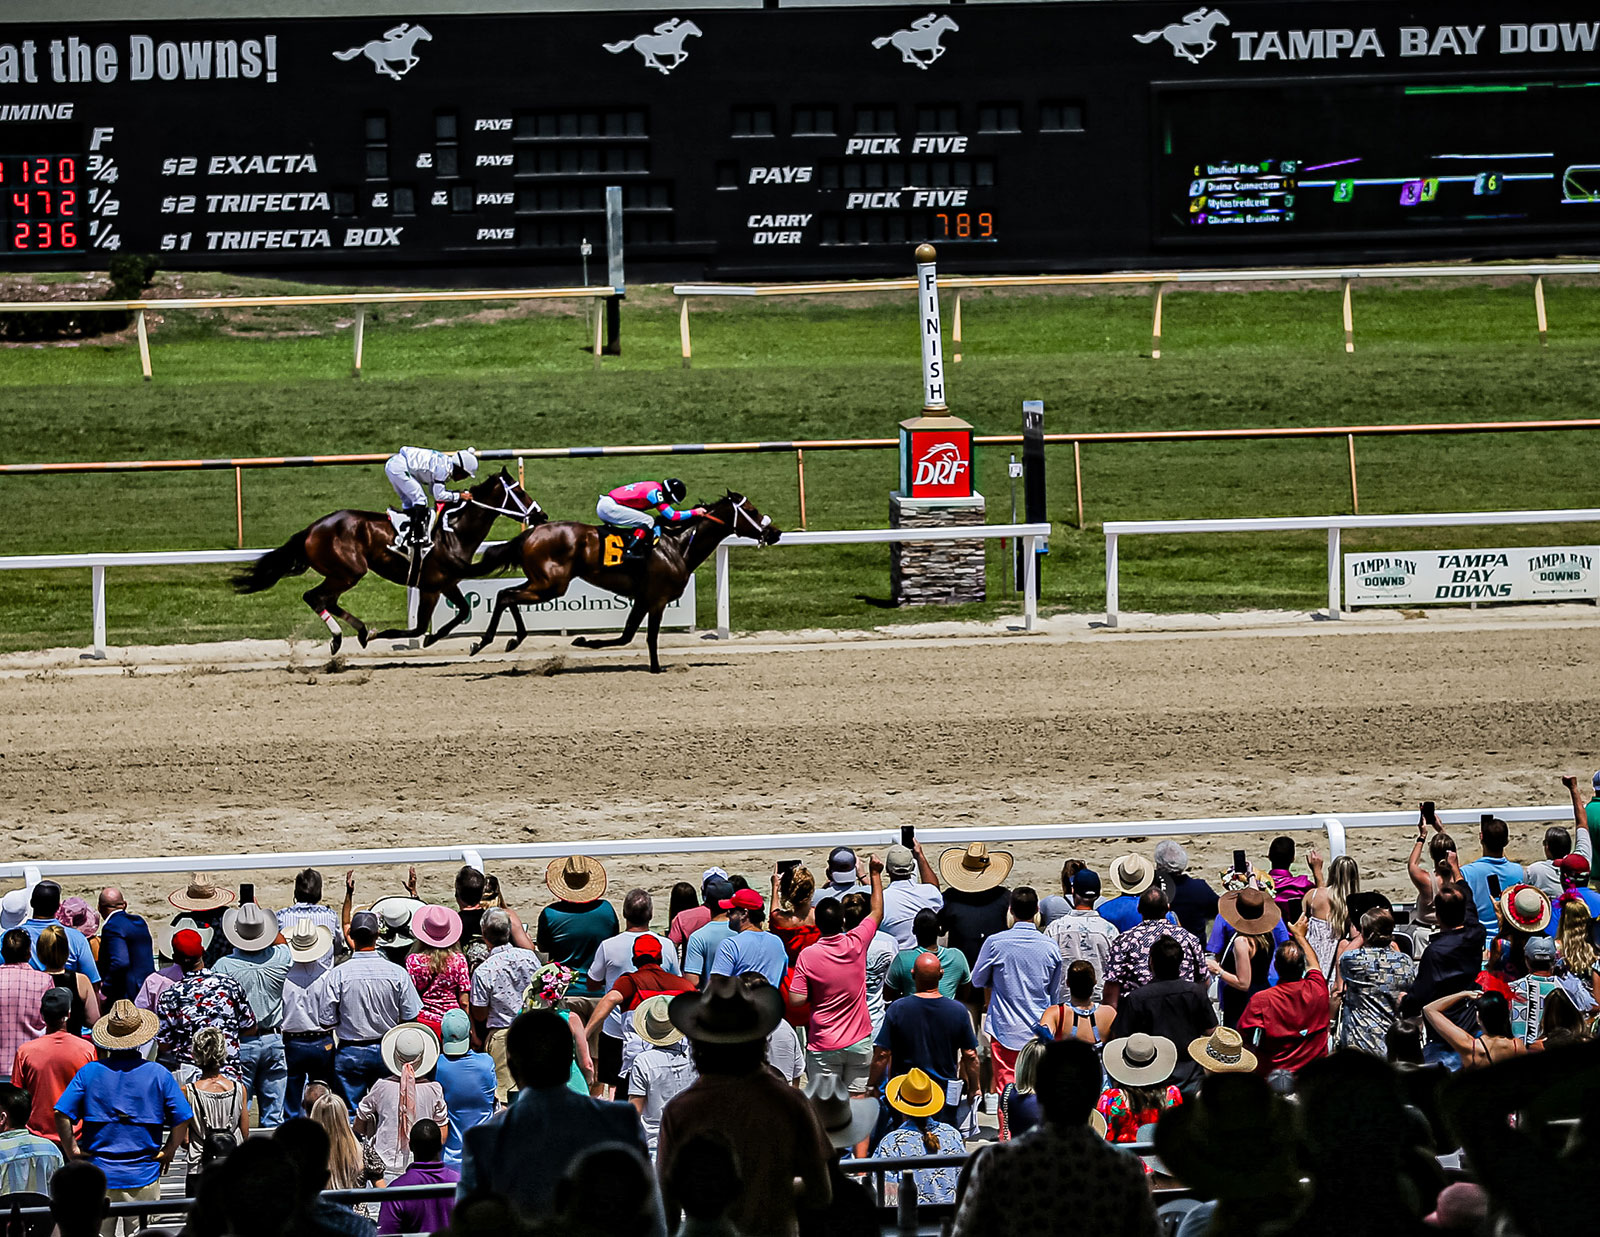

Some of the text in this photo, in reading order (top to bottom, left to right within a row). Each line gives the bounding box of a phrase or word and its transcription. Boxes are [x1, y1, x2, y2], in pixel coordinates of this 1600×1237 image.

[1232, 22, 1600, 61] TAMPA BAY DOW
[0, 34, 278, 83] at the Downs!
[0, 103, 74, 121] IMING
[475, 119, 513, 131] PAYS
[90, 127, 115, 151] F
[845, 136, 968, 155] PICK FIVE
[162, 153, 514, 176] $2 EXACTA & PAYS
[748, 166, 813, 184] PAYS
[13, 190, 76, 216] 472
[161, 191, 515, 213] $2 TRIFECTA & & PAYS
[846, 190, 968, 209] PICK FIVE
[747, 214, 812, 228] CARRY
[935, 213, 993, 237] 789
[15, 222, 77, 249] 236
[161, 227, 515, 250] $1 TRIFECTA BOX PAYS
[752, 231, 802, 244] OVER
[925, 274, 943, 400] FINISH
[912, 460, 969, 486] DRF
[603, 533, 624, 567] 6
[1352, 558, 1391, 577] TAMPA
[1437, 553, 1509, 569] TAMPA
[1527, 552, 1566, 572] TAMPA
[1364, 576, 1405, 587] DOWNS
[1451, 569, 1495, 583] BAY
[1540, 571, 1581, 582] DOWNS
[1435, 583, 1512, 599] DOWNS
